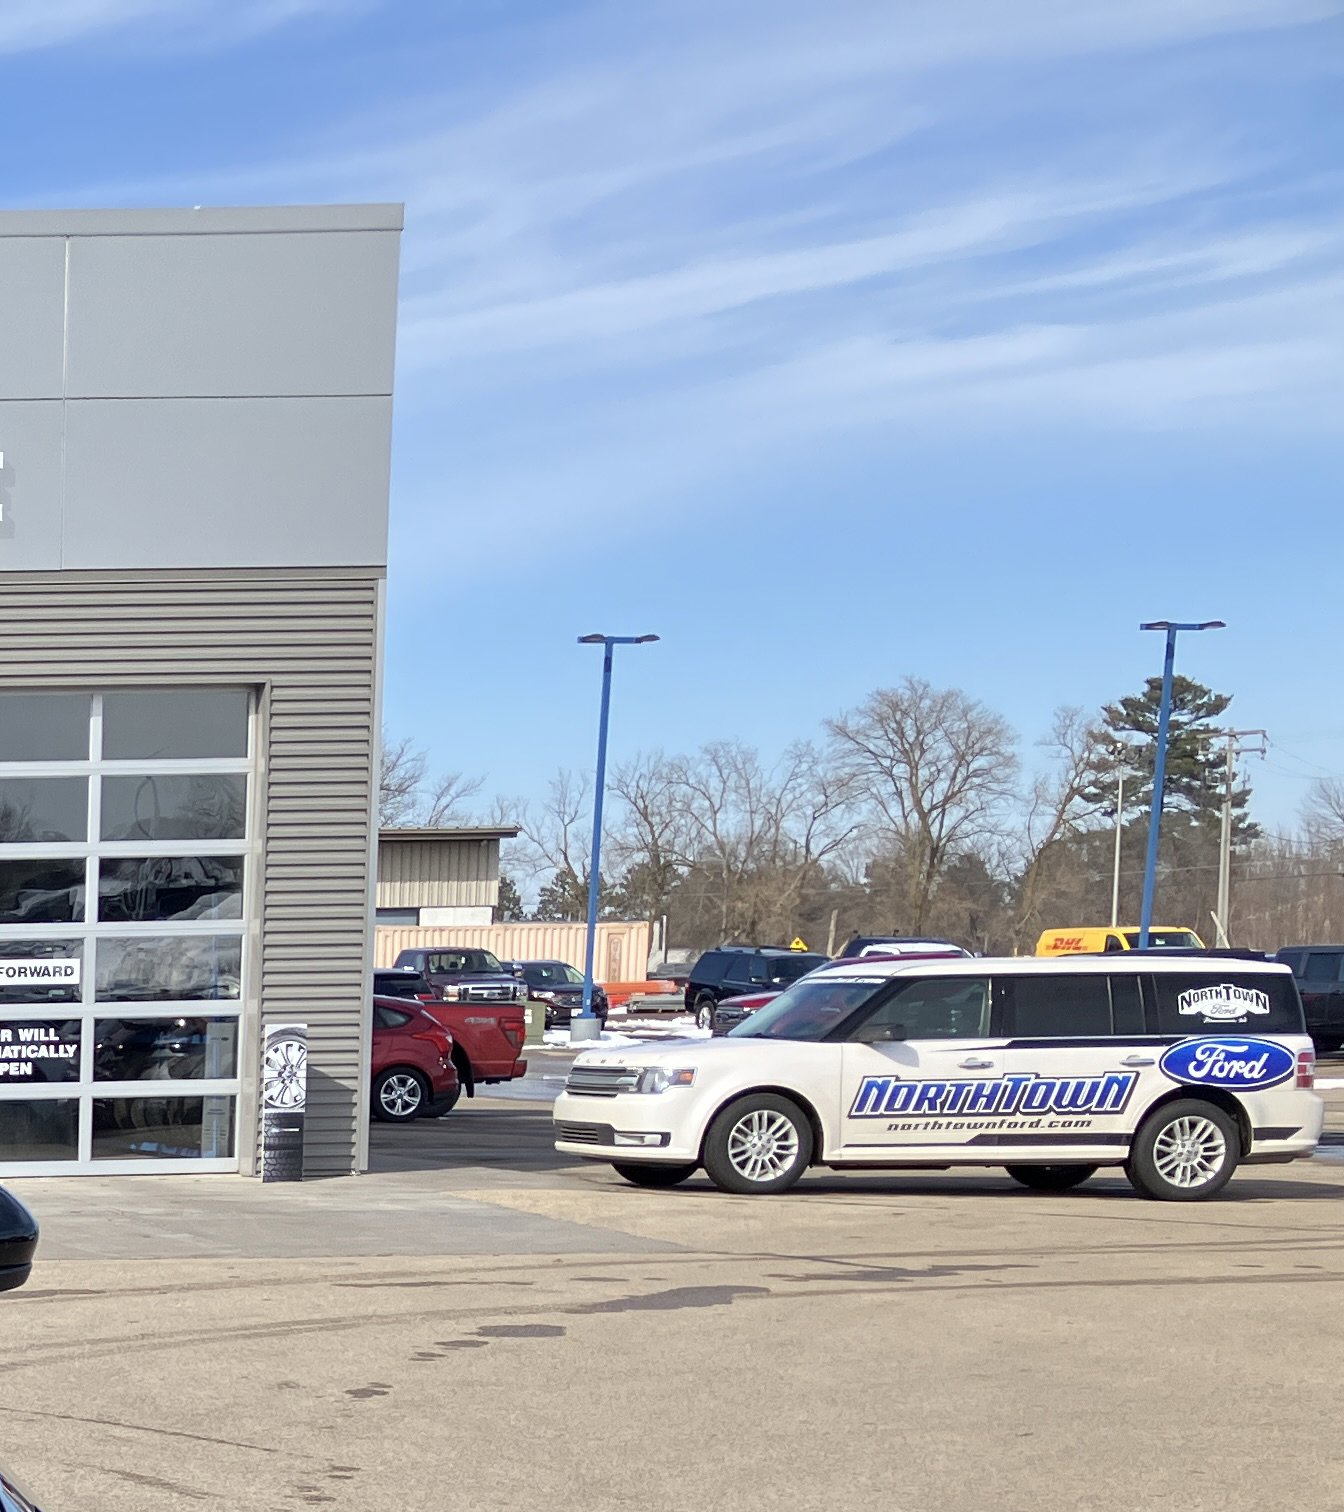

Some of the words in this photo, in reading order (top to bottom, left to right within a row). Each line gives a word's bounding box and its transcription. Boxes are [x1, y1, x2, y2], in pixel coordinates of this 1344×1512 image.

[1210, 1003, 1238, 1015] Ford
[18, 1028, 60, 1042] WILL
[1187, 1043, 1270, 1079] Ford
[886, 1118, 1093, 1131] northtownford.com
